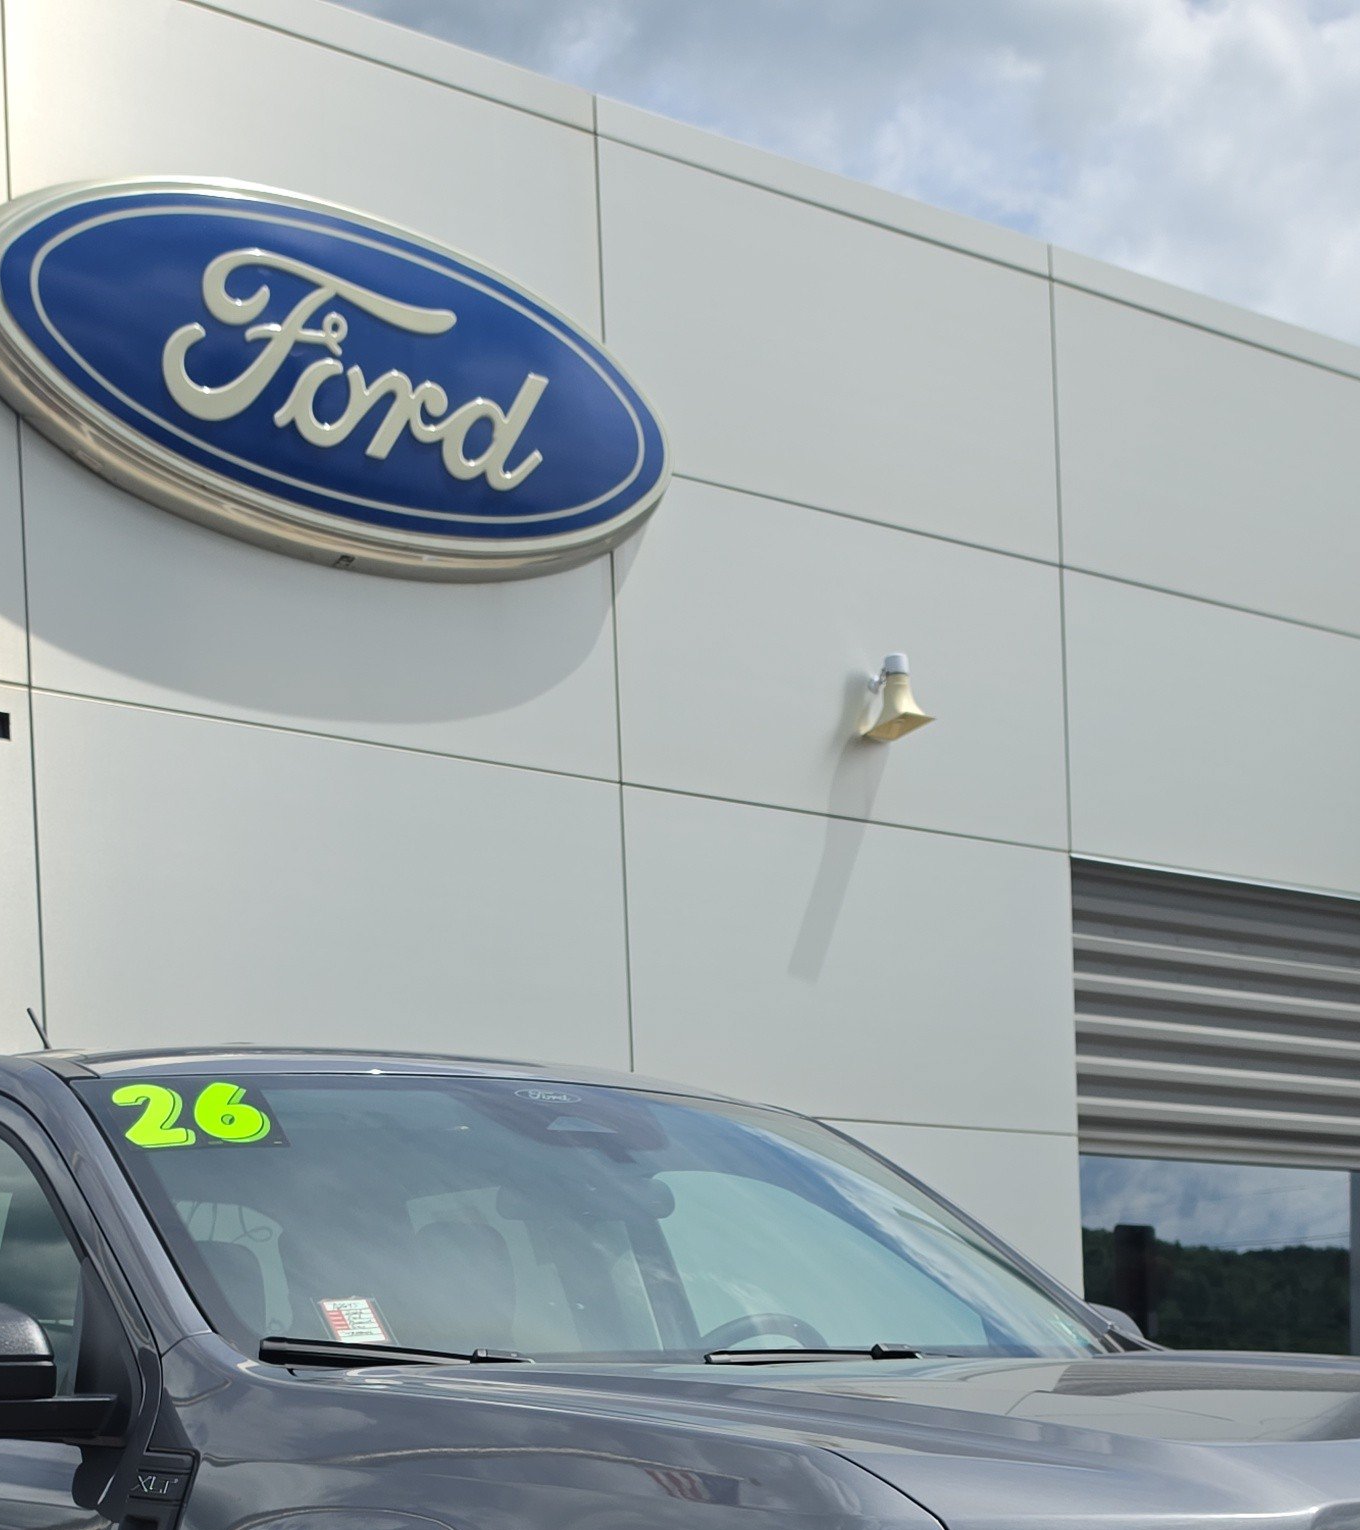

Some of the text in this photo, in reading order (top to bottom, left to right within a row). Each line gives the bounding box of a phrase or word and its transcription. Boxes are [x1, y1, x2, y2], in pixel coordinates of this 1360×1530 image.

[162, 248, 549, 493] Ford
[112, 1081, 271, 1147] 26
[131, 1475, 179, 1494] XLT
